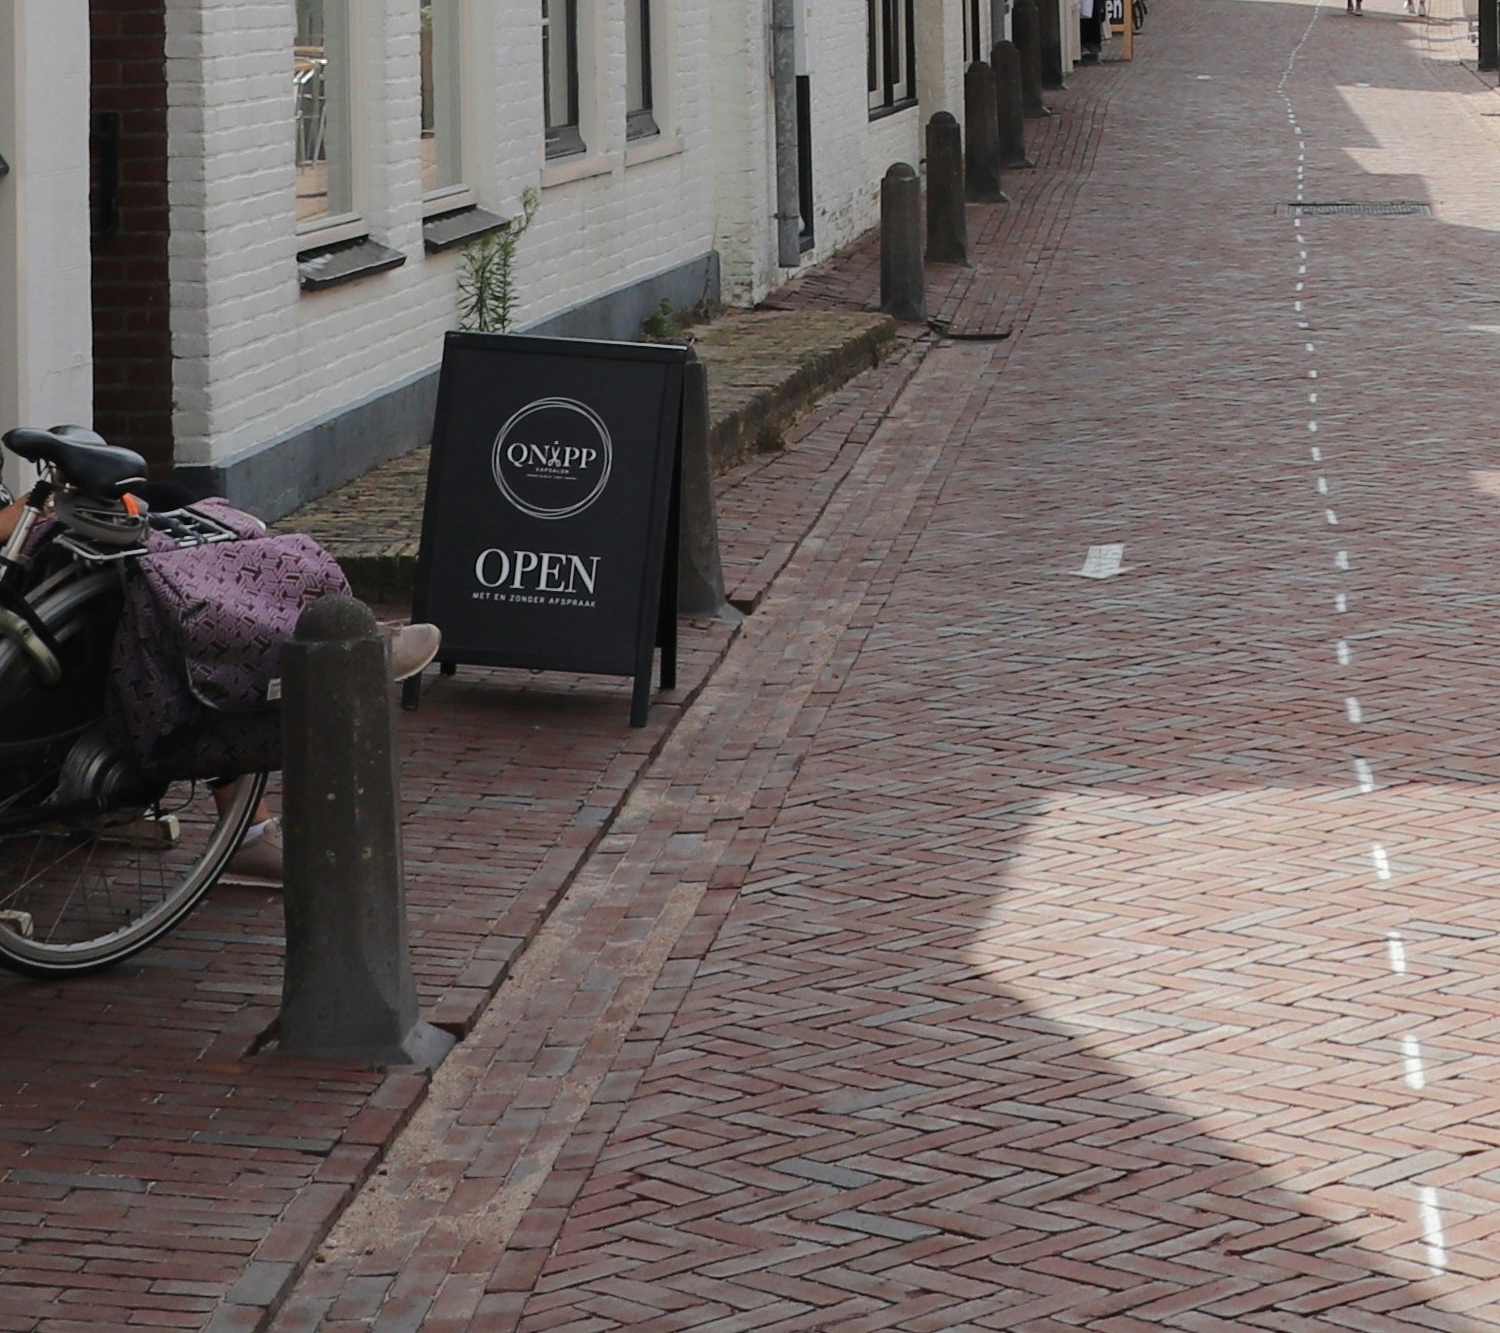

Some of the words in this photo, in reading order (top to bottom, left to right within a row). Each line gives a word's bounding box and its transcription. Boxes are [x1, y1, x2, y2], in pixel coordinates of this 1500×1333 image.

[475, 548, 602, 594] OPEN
[472, 592, 491, 600] MET
[509, 594, 545, 604] ZONDER
[548, 597, 596, 608] AFSPRAAK
